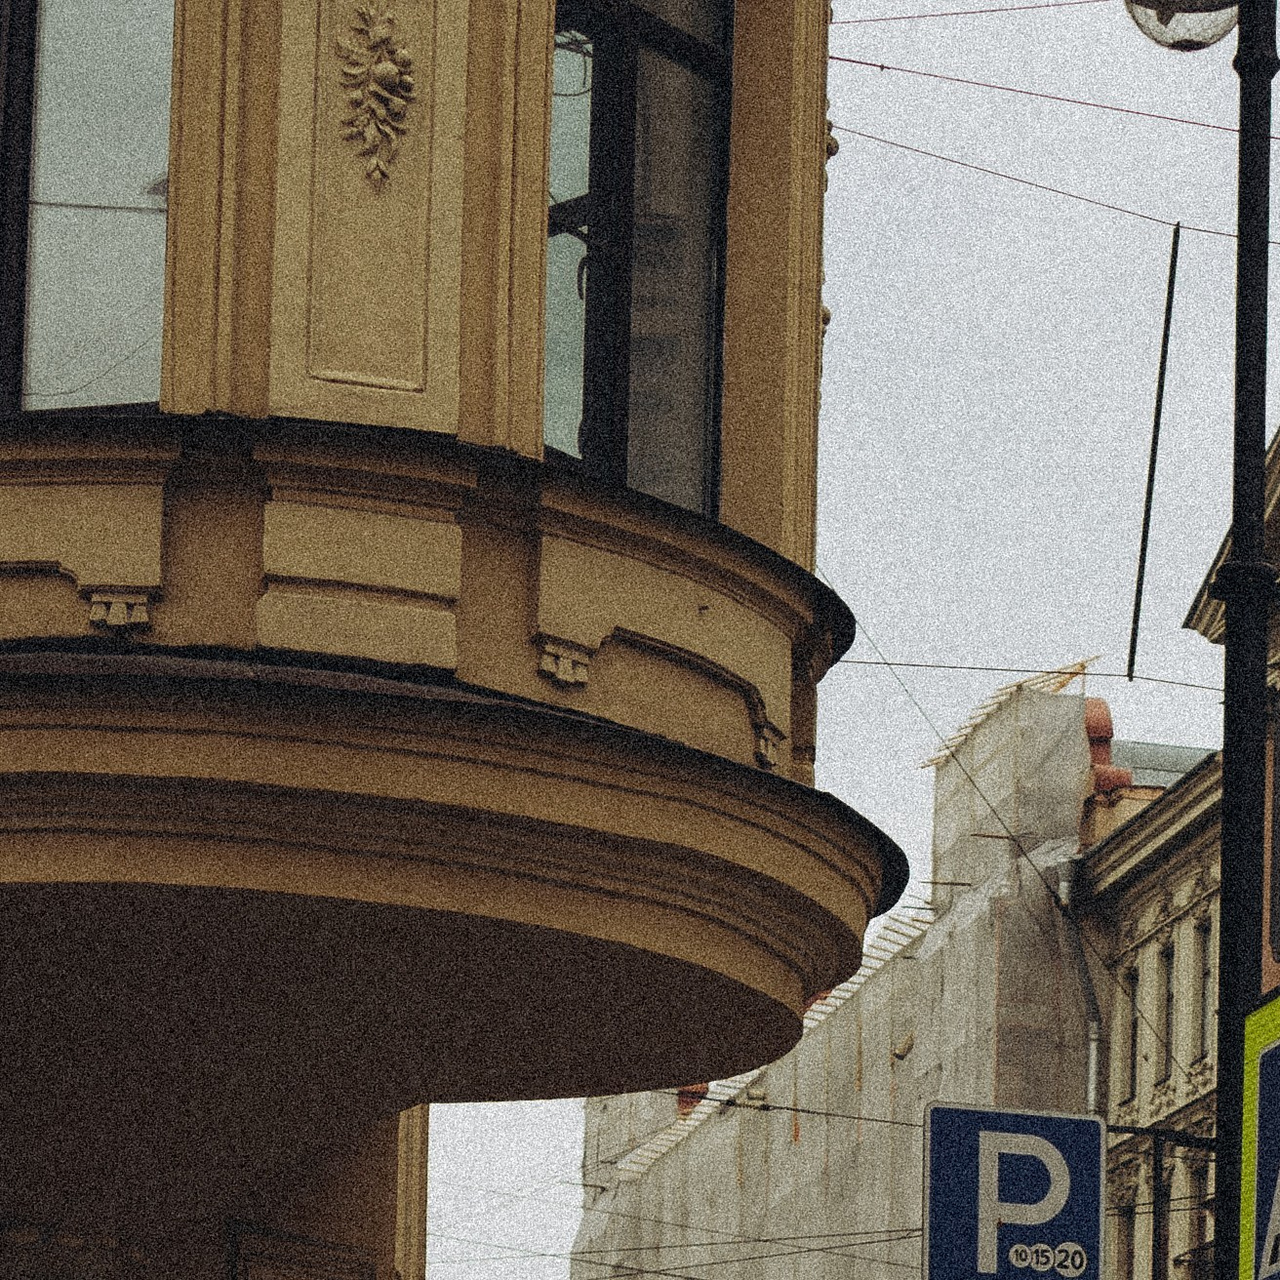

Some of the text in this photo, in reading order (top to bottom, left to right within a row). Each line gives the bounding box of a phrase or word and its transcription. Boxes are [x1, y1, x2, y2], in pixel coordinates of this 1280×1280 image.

[977, 1130, 1070, 1274] P
[1013, 1248, 1085, 1270] 10 15 20
